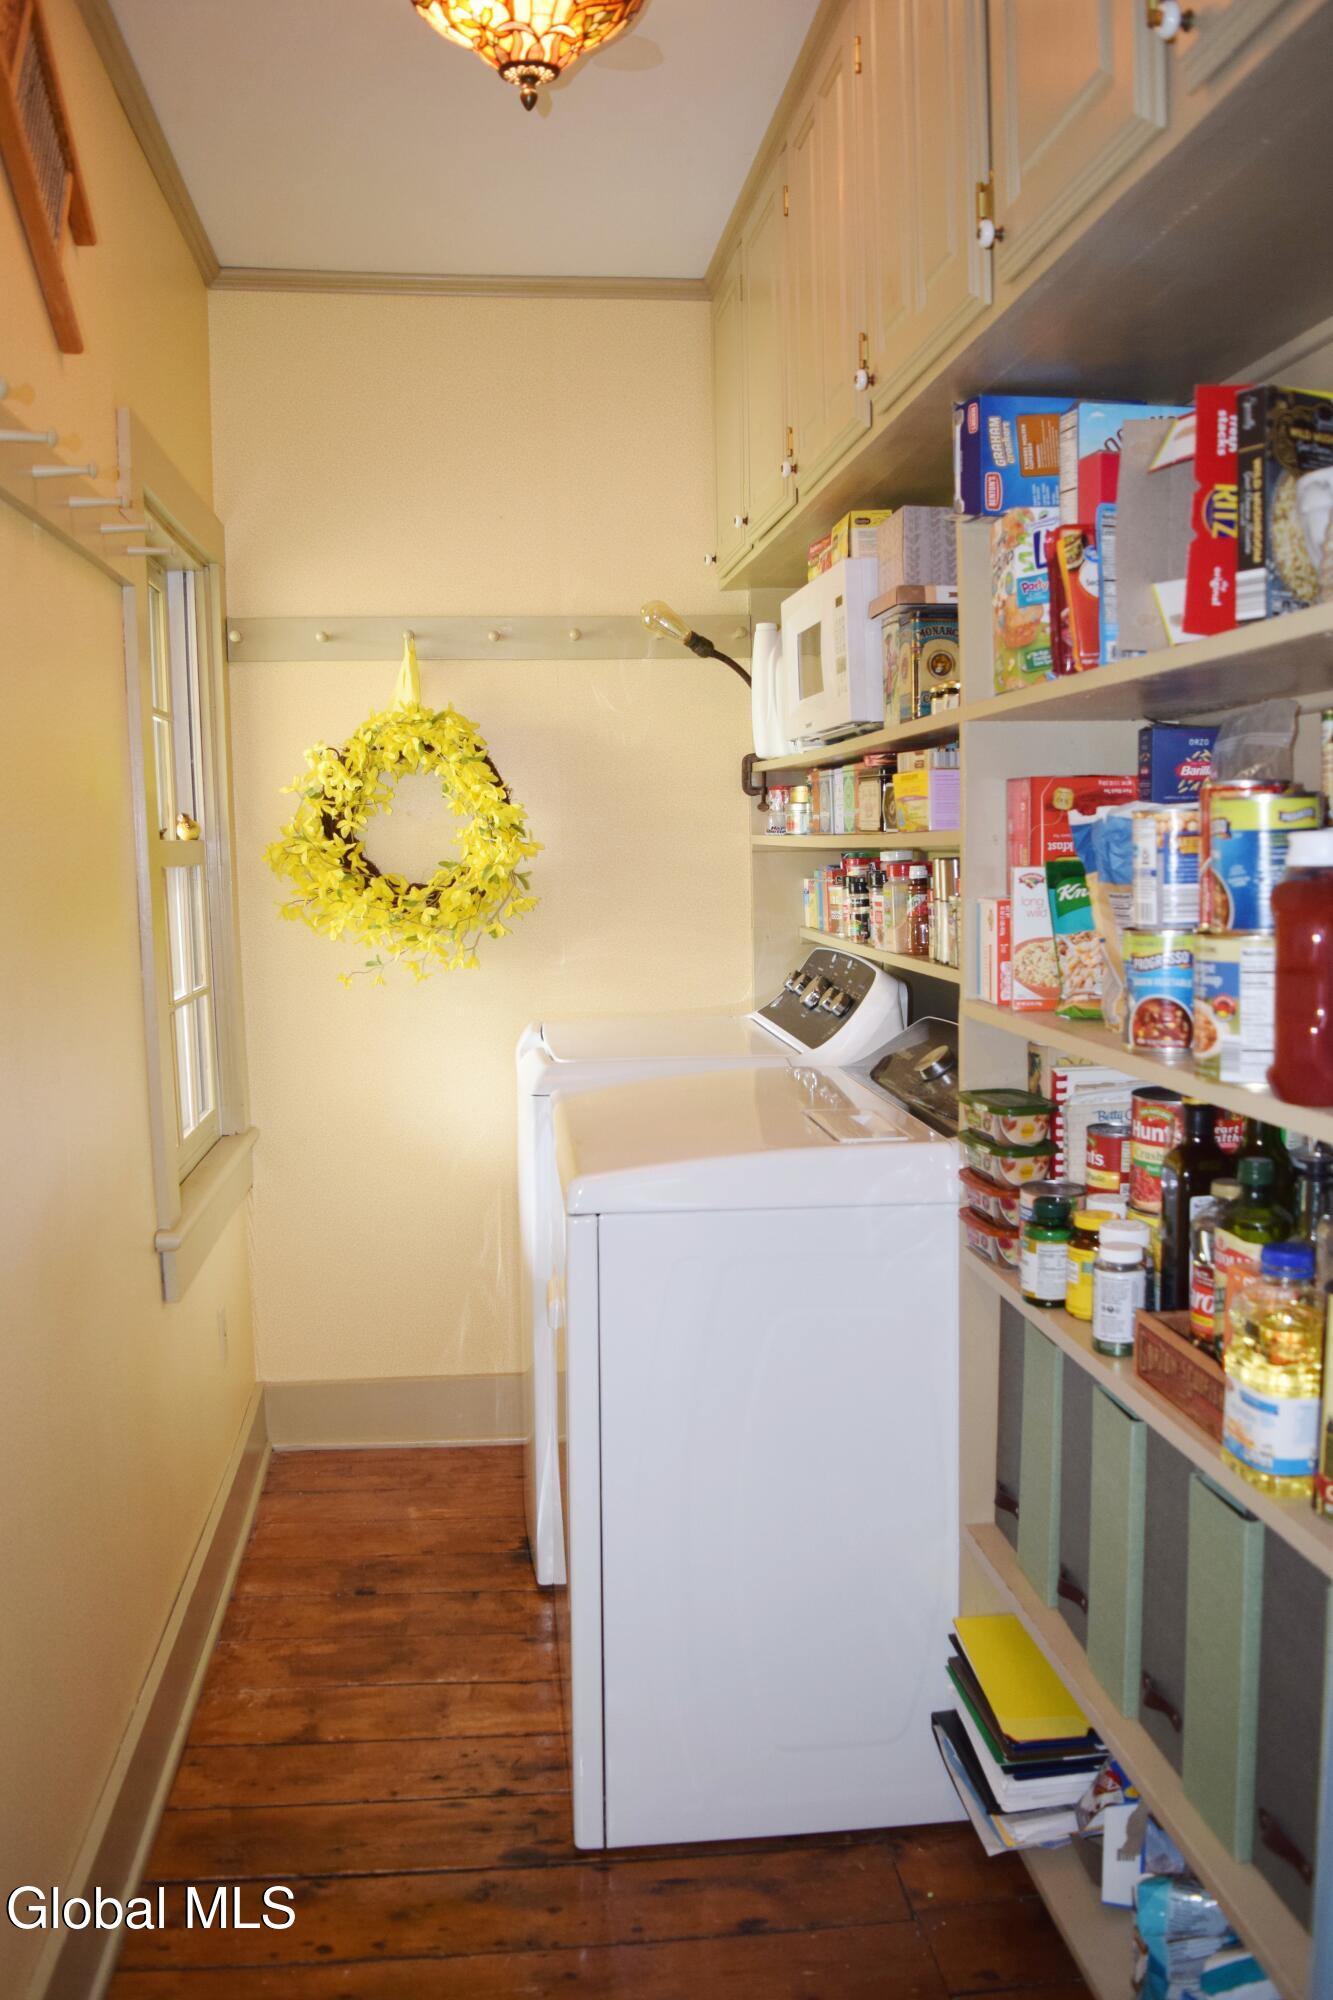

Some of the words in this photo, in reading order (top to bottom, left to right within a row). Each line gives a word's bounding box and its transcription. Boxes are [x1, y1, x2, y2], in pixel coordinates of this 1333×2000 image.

[989, 416, 1006, 467] GRAHAM
[1216, 409, 1229, 456] stacks
[1212, 484, 1238, 539] RITZ
[1188, 738, 1209, 746] ORZO
[1097, 1110, 1122, 1122] Betty
